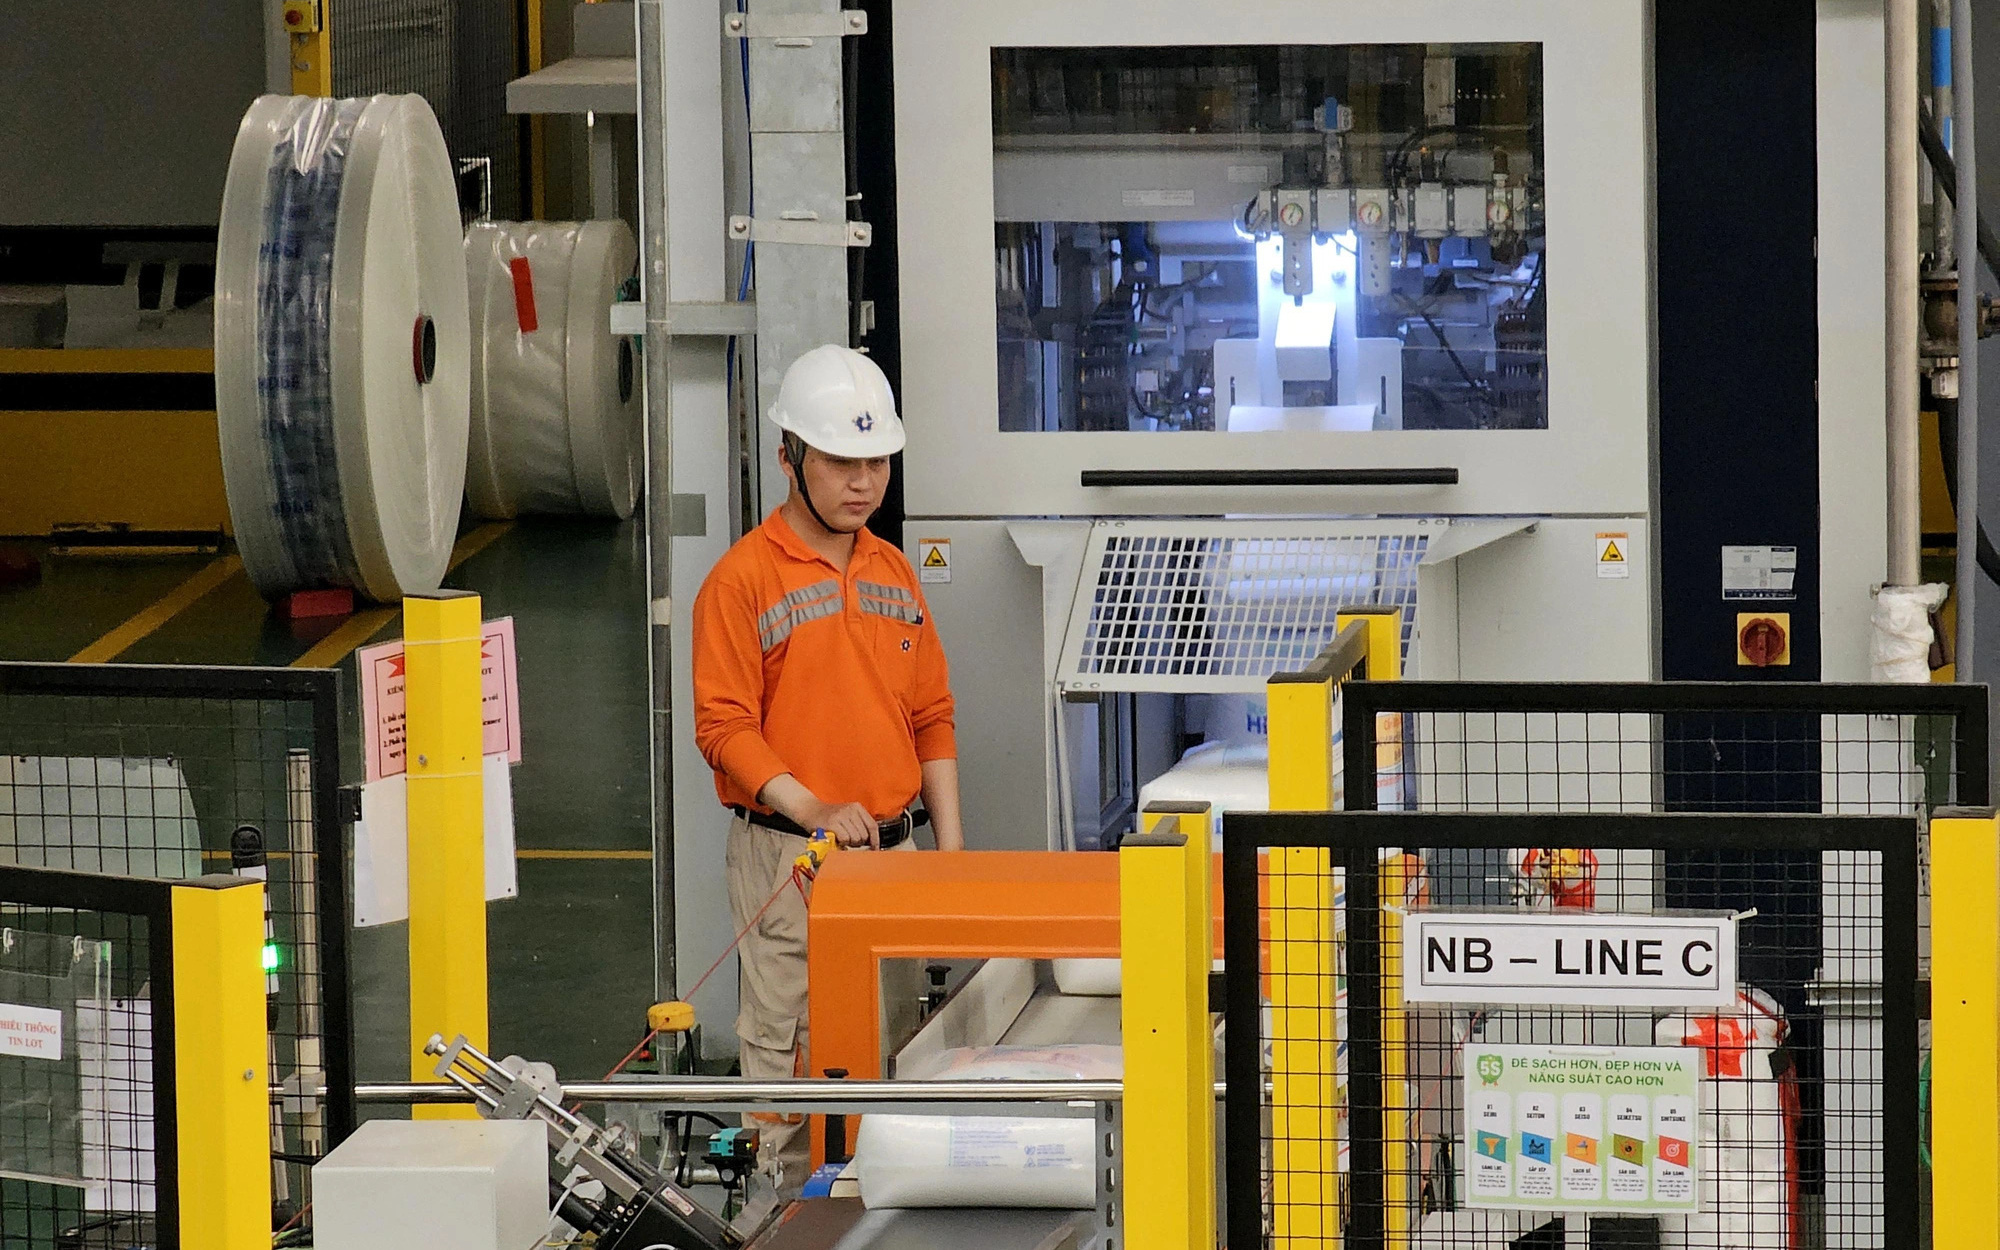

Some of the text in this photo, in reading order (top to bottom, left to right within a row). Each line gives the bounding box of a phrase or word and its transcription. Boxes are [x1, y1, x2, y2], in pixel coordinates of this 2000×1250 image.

[481, 667, 492, 675] OT
[1427, 936, 1494, 974] NB
[1554, 938, 1664, 976] LINE
[1681, 940, 1714, 977] C
[8, 1036, 44, 1049] TIN LOT
[1480, 1061, 1501, 1076] 5S
[1532, 1059, 1567, 1071] SẠCH
[1605, 1060, 1630, 1072] ĐẸP
[1633, 1061, 1662, 1071] HƠN
[1665, 1060, 1682, 1072] VÀ
[1529, 1071, 1565, 1084] NĂNG
[1605, 1074, 1633, 1085] CAO
[1636, 1075, 1664, 1086] HƠN
